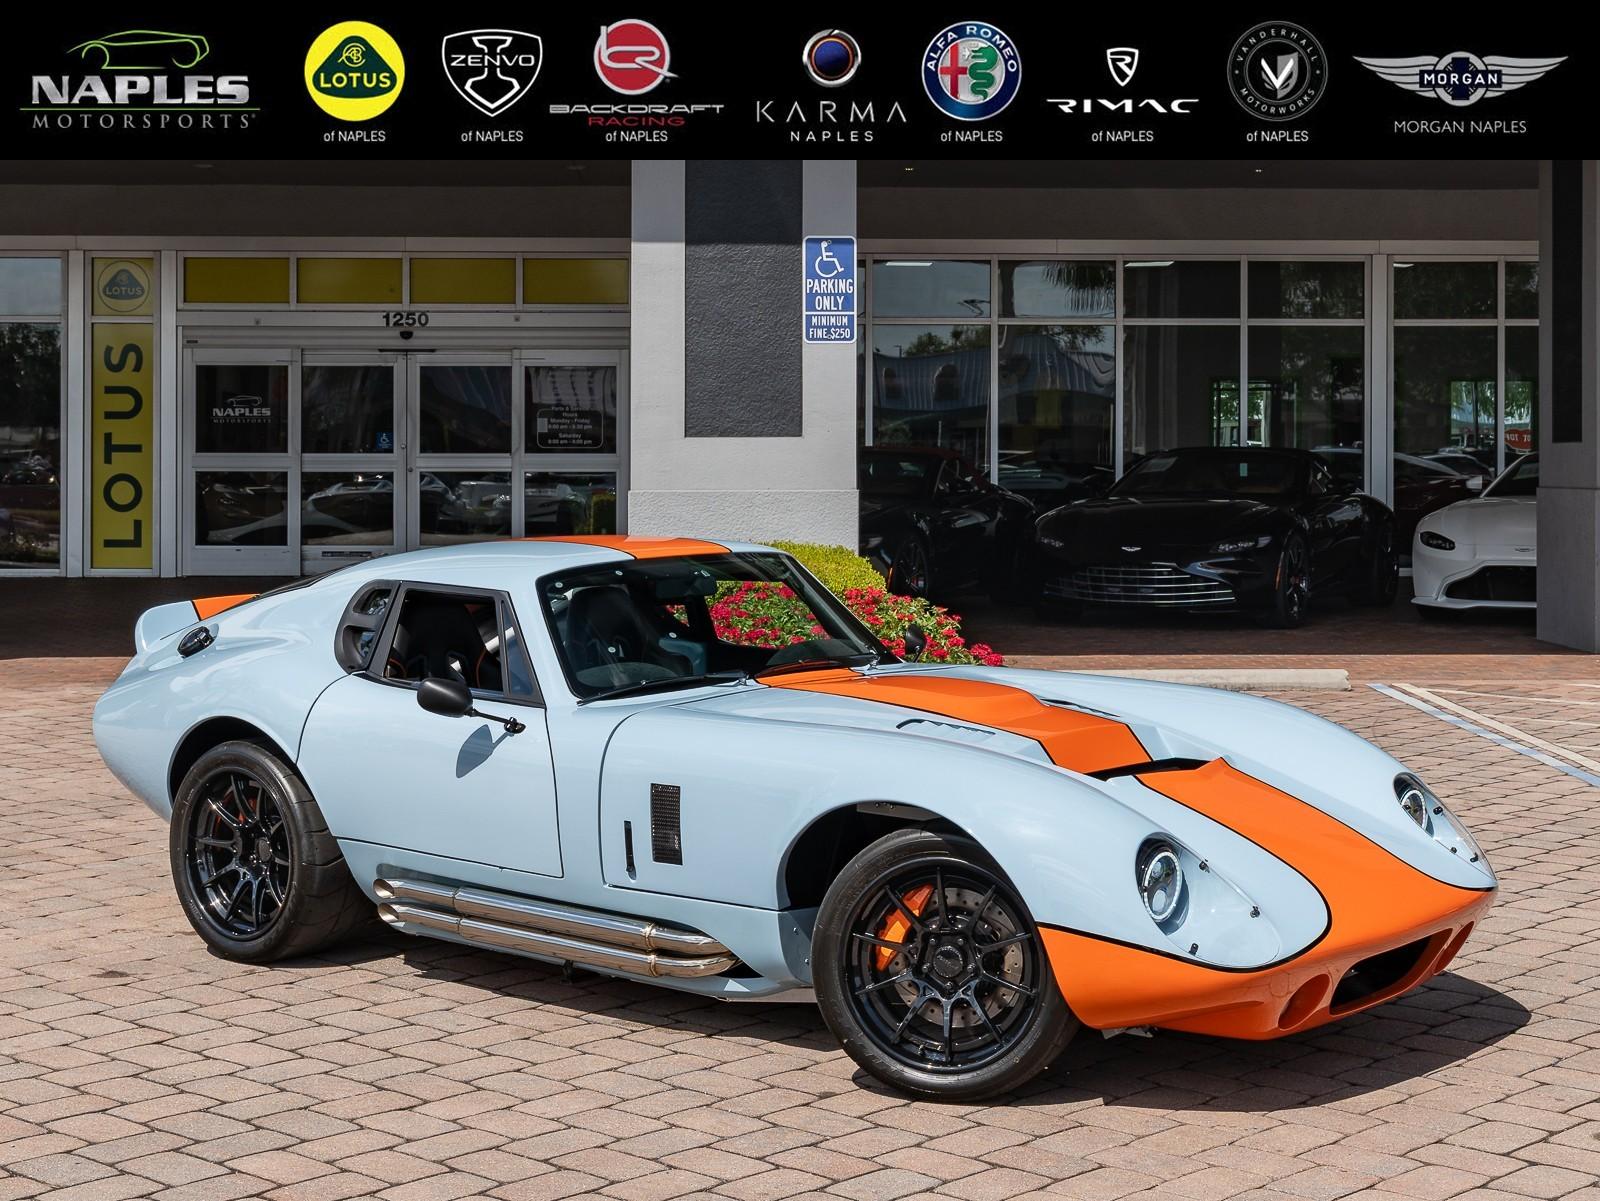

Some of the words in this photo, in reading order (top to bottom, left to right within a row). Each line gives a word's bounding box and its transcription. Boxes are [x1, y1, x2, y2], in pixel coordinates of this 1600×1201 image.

[105, 286, 143, 296] LOTUS
[806, 278, 853, 294] PARKING
[815, 295, 845, 311] ONLY
[382, 311, 430, 328] 1250
[811, 315, 849, 326] MINIMUM
[809, 328, 828, 339] FINE
[830, 327, 851, 339] $250
[212, 407, 271, 417] NAPLES
[103, 343, 143, 548] LOTUS
